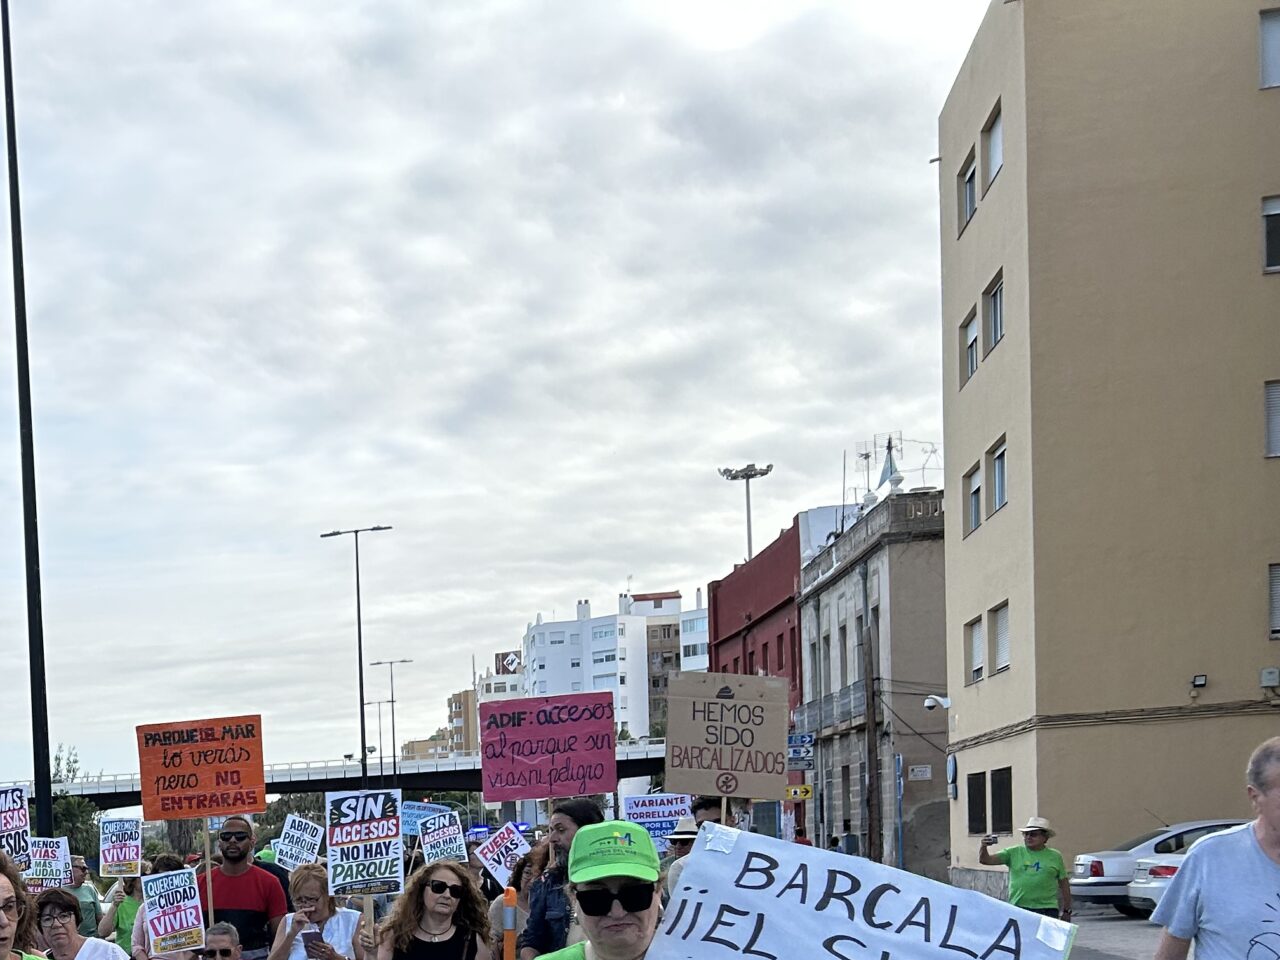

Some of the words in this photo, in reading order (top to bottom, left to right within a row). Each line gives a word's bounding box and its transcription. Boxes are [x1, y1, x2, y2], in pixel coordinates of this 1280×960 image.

[487, 711, 533, 729] ADIF:
[536, 702, 614, 725] accesos
[692, 701, 764, 726] HEMOS
[144, 729, 198, 747] PARQUE
[222, 724, 255, 740] MAR
[705, 724, 755, 747] SIDO
[190, 743, 250, 766] verás
[485, 731, 506, 759] al
[509, 735, 578, 766] parque
[585, 733, 611, 751] sin
[671, 746, 785, 775] BARCALIZADOS
[155, 773, 198, 795] pero
[216, 770, 240, 786] NO
[547, 757, 604, 794] peligro
[340, 795, 384, 823] SIN
[103, 821, 137, 833] QUEREMOS
[290, 819, 318, 838] ABRID
[332, 819, 397, 844] ACCESOS
[424, 825, 459, 843] ACCESOS
[426, 815, 449, 833] SIN
[31, 840, 60, 849] MENOS
[110, 831, 139, 844] CIUDAD
[283, 832, 317, 854] PARQUE
[429, 841, 441, 850] NO
[442, 836, 458, 848] HAY
[480, 826, 515, 860] FUERA
[104, 846, 137, 862] VIVIR
[340, 846, 362, 862] NO
[364, 841, 392, 859] HAY
[427, 844, 464, 862] PARQUE
[332, 858, 400, 884] PARQUE
[147, 874, 190, 895] QUEREMOS
[157, 886, 196, 909] CIUDAD
[153, 908, 198, 935] VIVIR
